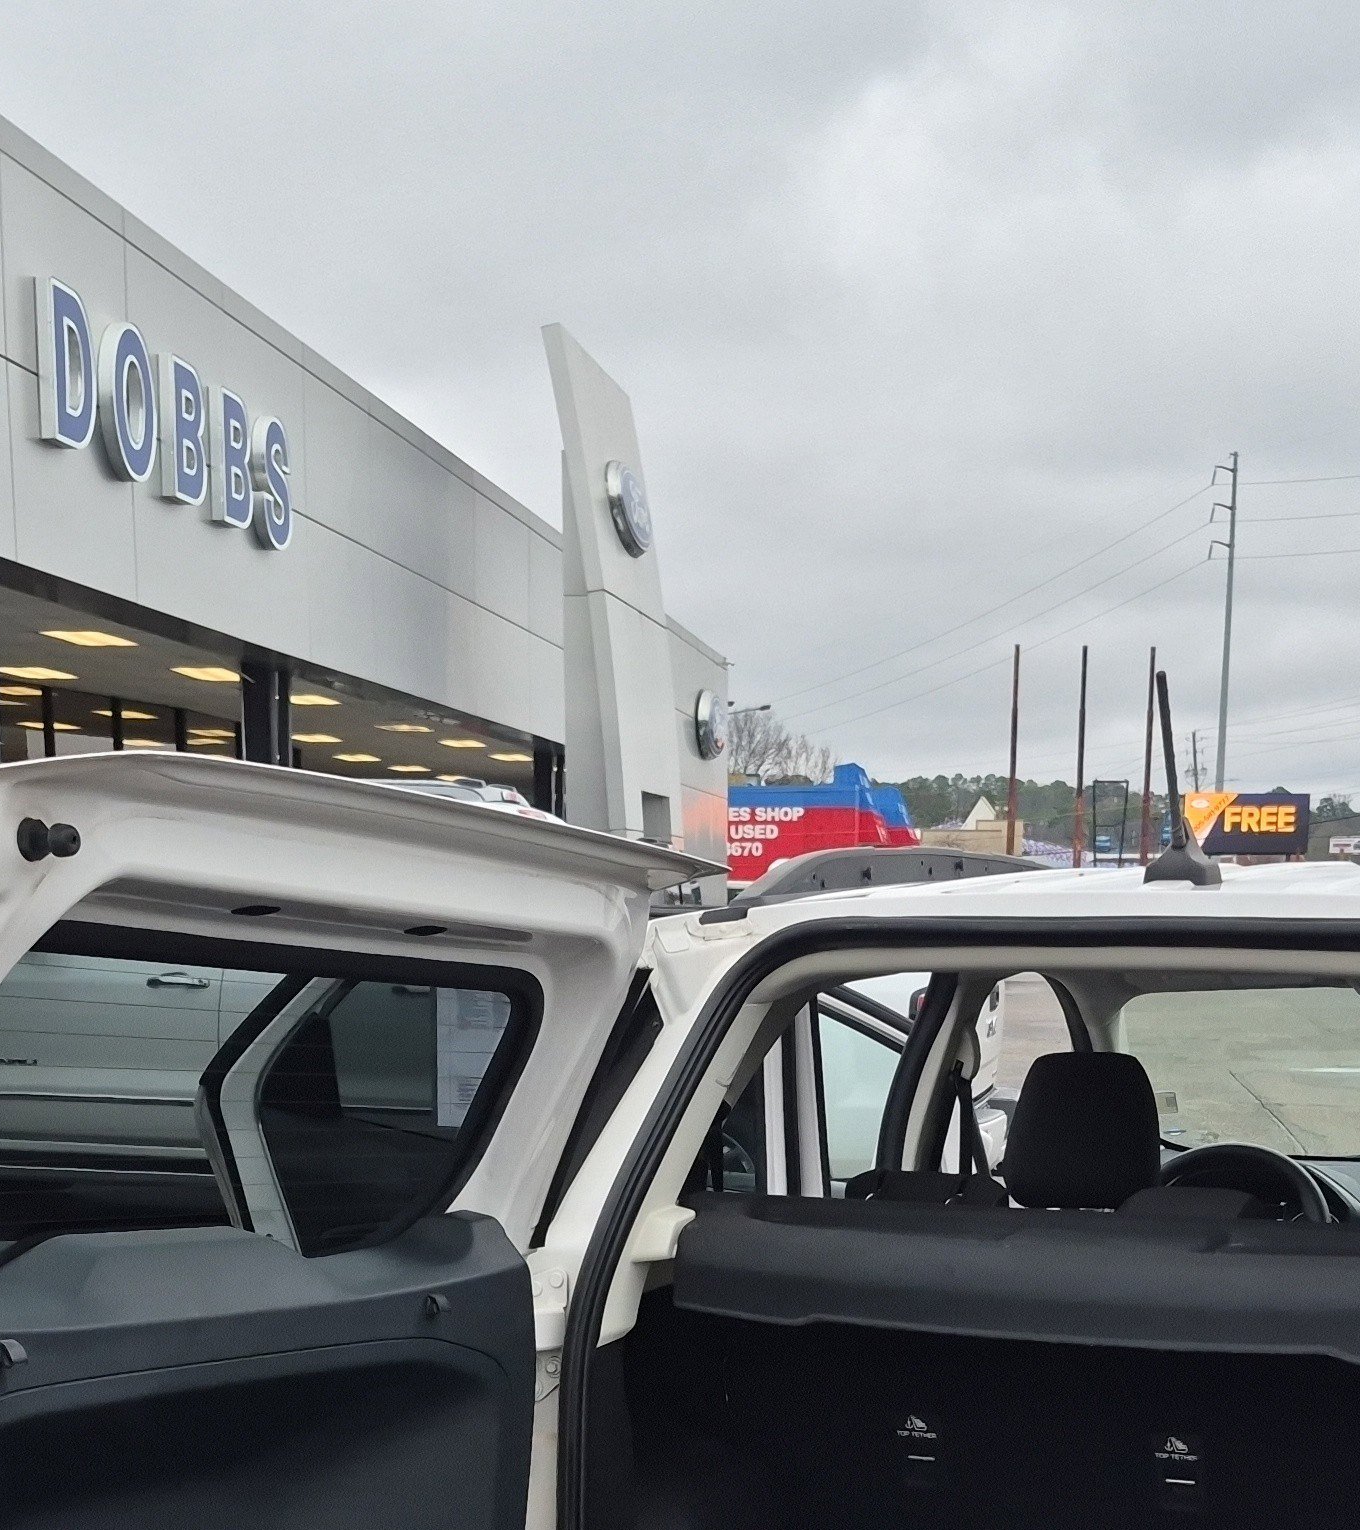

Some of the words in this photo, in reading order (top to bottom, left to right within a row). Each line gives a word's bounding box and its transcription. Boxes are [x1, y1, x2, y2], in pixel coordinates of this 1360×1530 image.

[37, 275, 292, 551] DOBBS
[754, 807, 805, 822] SHOP
[1223, 805, 1297, 833] FREE
[730, 824, 779, 840] USED
